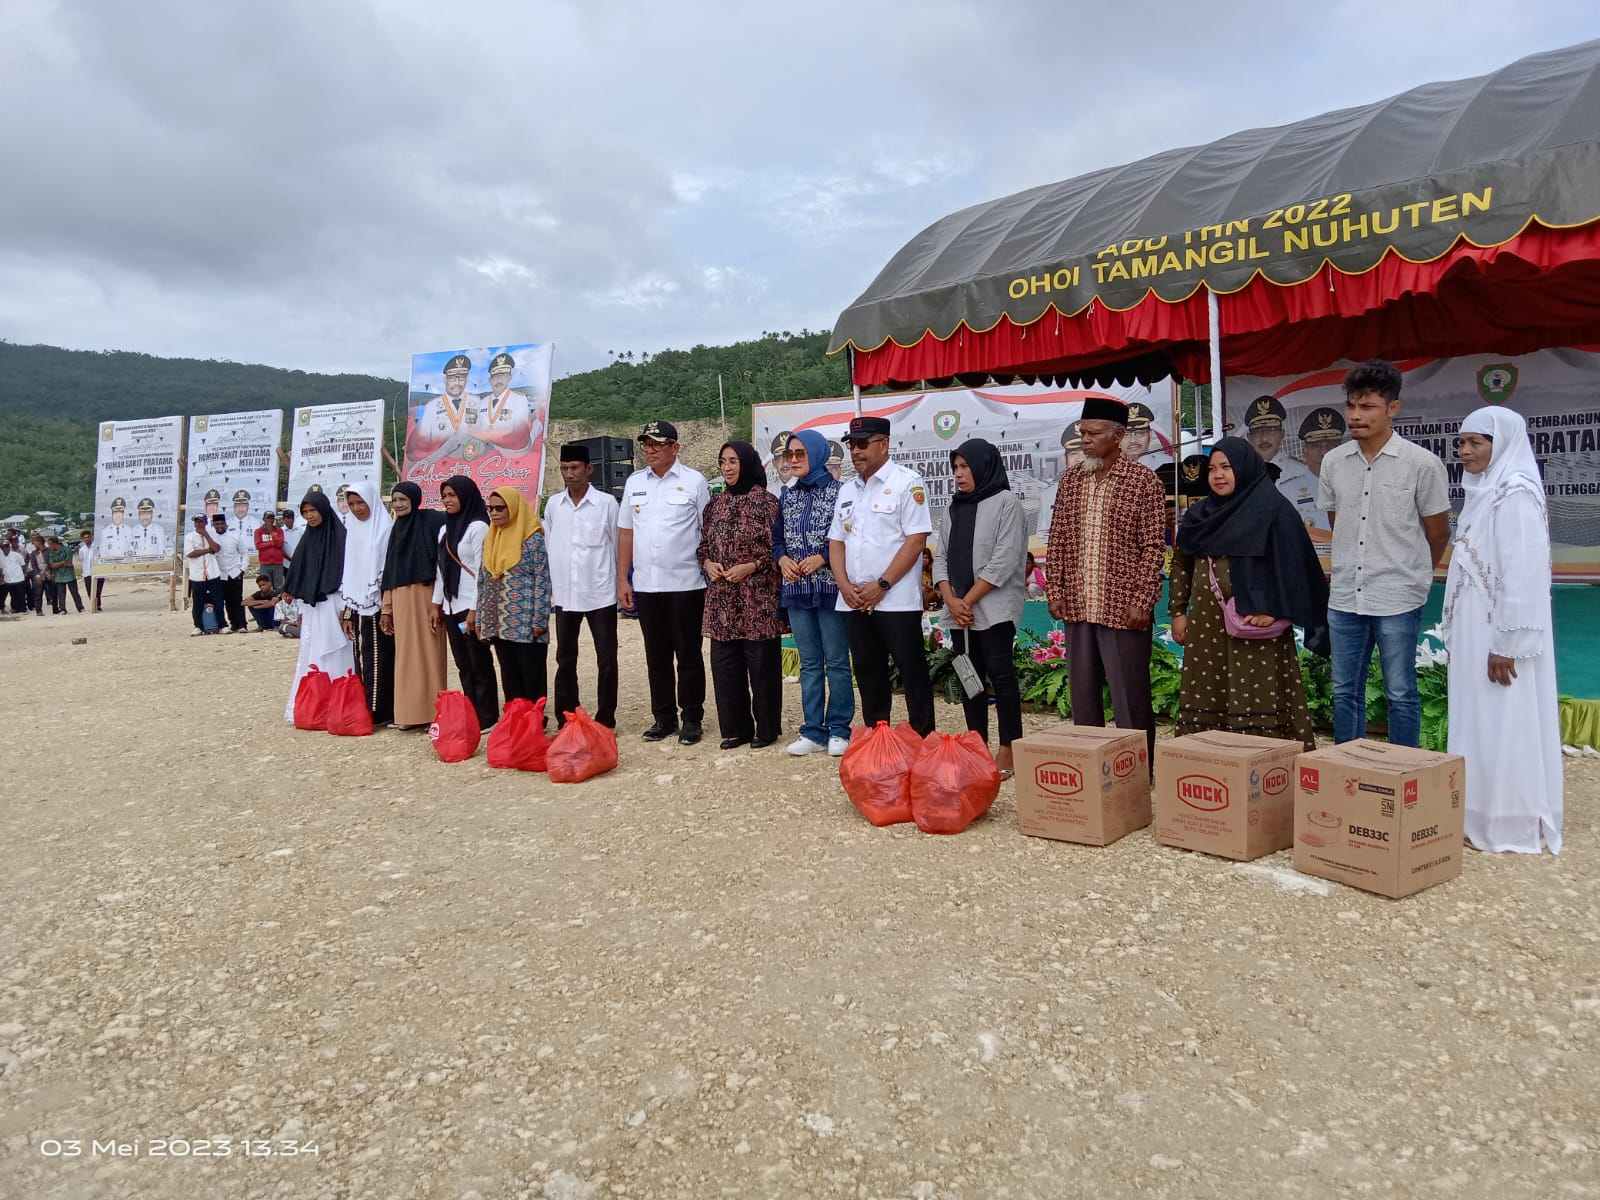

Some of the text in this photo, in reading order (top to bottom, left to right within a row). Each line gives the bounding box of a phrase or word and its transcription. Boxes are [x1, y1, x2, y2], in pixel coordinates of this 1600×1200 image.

[1263, 193, 1352, 229] 2022
[1008, 187, 1493, 299] OHOI TAMANGIL NUHUTEN
[1528, 412, 1600, 428] PEMBANGUN
[1039, 769, 1078, 788] HOCK
[1265, 773, 1287, 790] HOCK
[1182, 782, 1223, 803] HOCK
[1348, 824, 1390, 842] DEB33C
[1411, 824, 1439, 842] DEB33C
